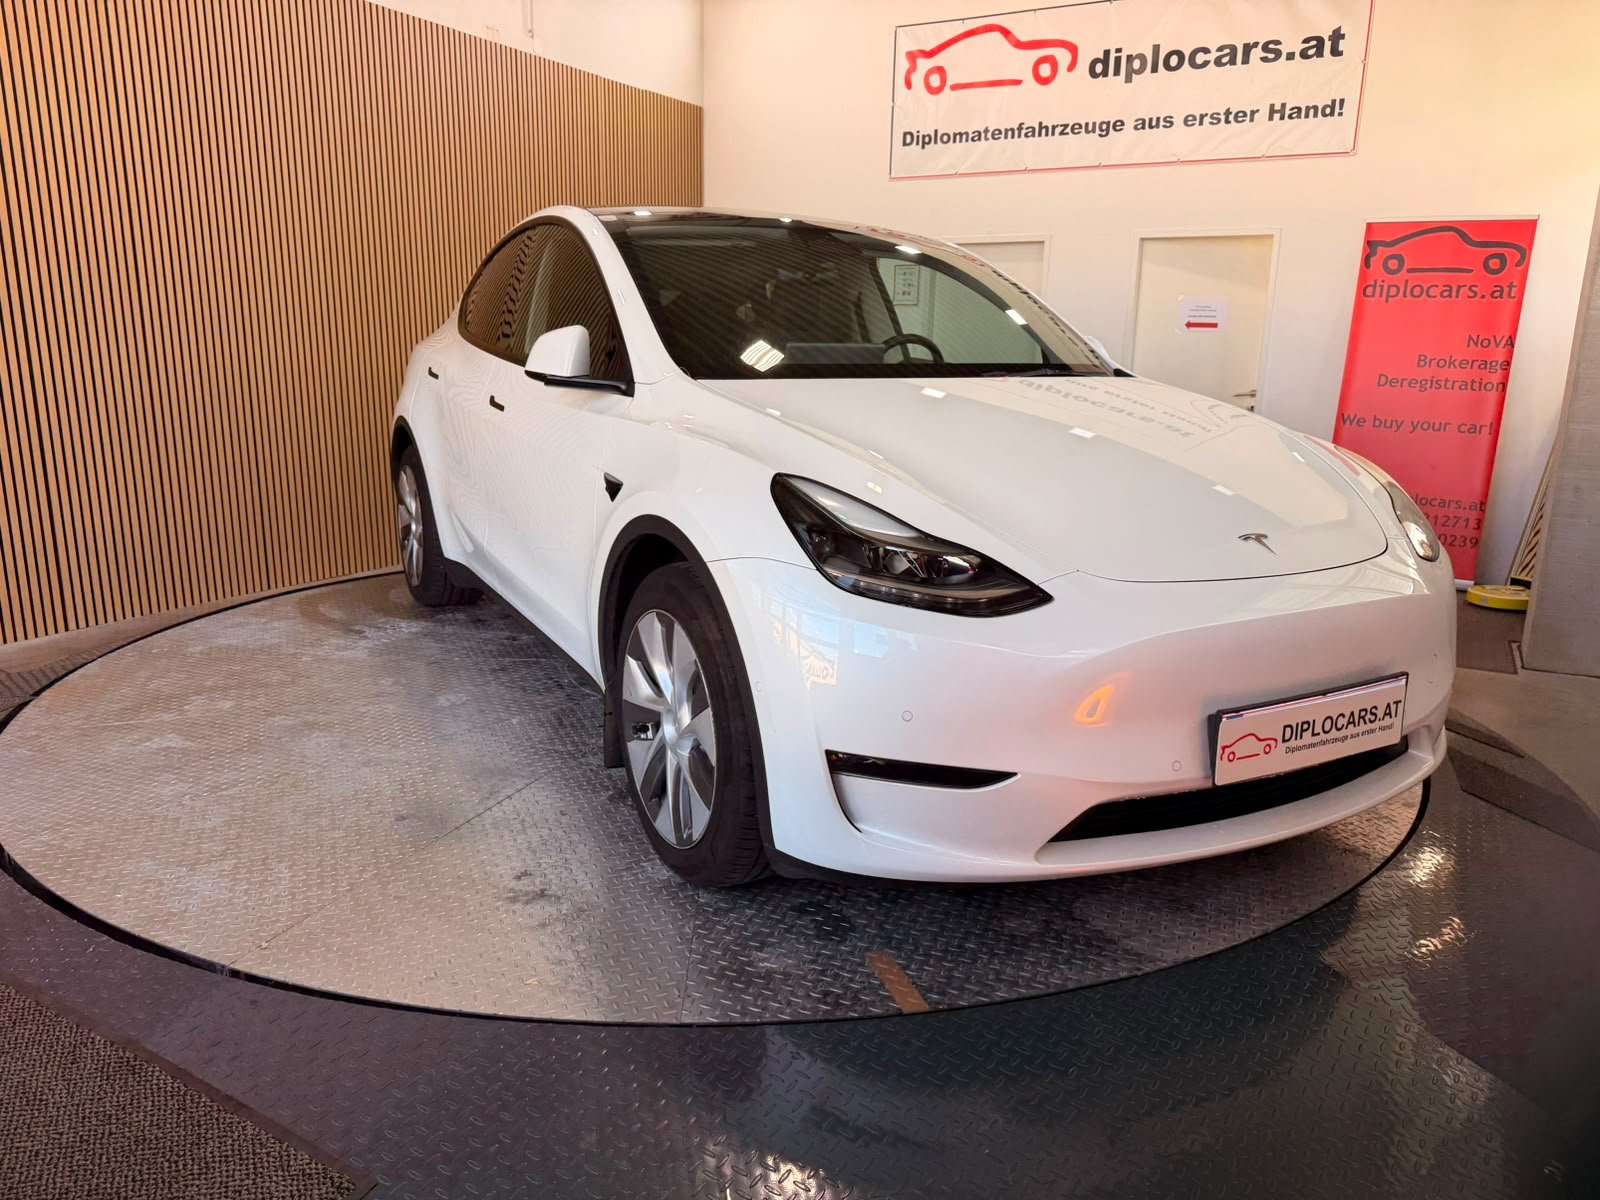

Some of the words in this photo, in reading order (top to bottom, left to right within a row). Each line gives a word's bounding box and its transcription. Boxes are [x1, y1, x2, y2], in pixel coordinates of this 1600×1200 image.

[1088, 25, 1346, 84] diplocars.at
[901, 119, 1125, 149] Diplomatenfahrzeuge
[1133, 114, 1175, 131] aus
[1183, 107, 1260, 127] erster
[1267, 98, 1345, 122] Hand!
[1362, 279, 1518, 303] diplocars.at
[1466, 333, 1516, 349] NoVA
[1416, 353, 1511, 374] Brokerage
[1376, 373, 1506, 393] Deregistration
[1341, 412, 1367, 428] We
[1372, 414, 1404, 432] buy
[1410, 419, 1450, 434] your
[1457, 421, 1494, 436] car!
[1411, 494, 1487, 512] locars.at
[1281, 699, 1402, 744] DIPLOCARS.AT
[1285, 735, 1349, 754] Diplomatenfahrzeuge
